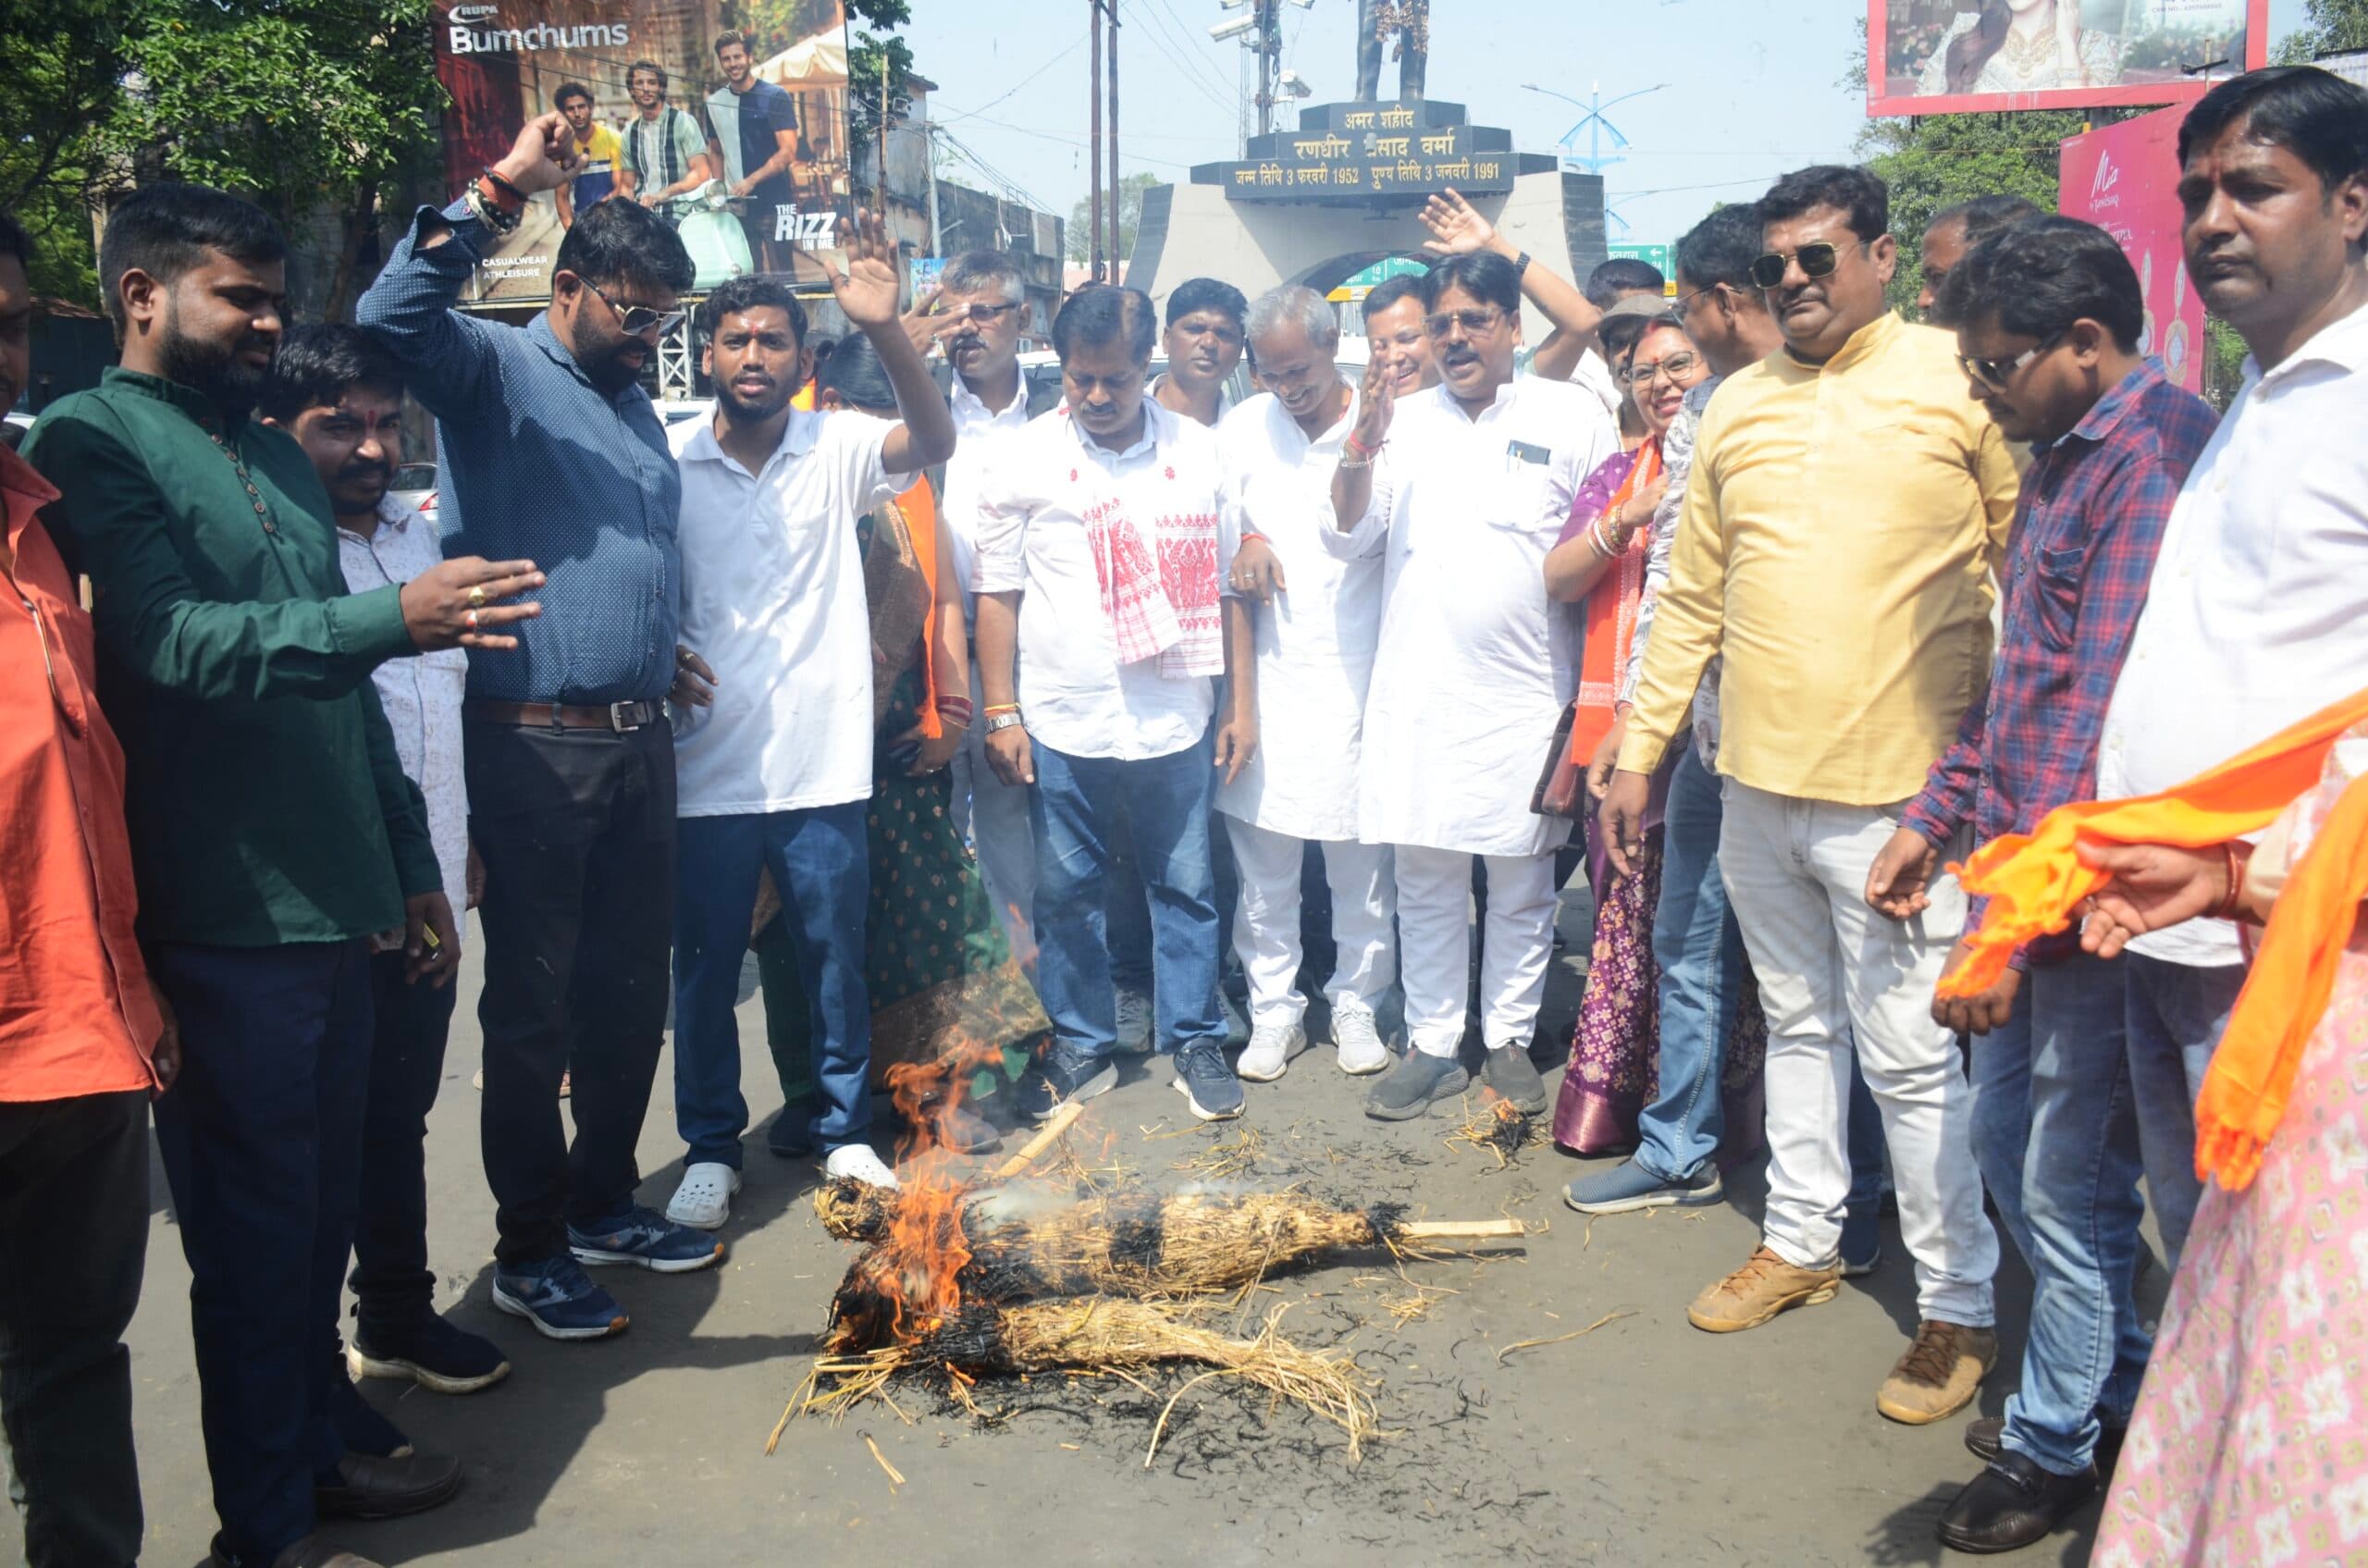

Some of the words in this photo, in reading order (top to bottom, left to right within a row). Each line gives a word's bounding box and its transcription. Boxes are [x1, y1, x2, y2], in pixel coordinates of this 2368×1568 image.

[461, 5, 498, 15] RUPA
[449, 22, 630, 54] Bumchums
[1345, 111, 1375, 130] अमर
[1379, 104, 1414, 129] शहीद
[1294, 133, 1351, 160] रणधीर
[1420, 128, 1455, 155] वर्मा
[1235, 170, 1257, 185] जन्म
[1259, 163, 1284, 186] तिथि
[1287, 169, 1293, 185] 3
[1297, 162, 1328, 185] फरवरी
[1332, 167, 1359, 184] 1952
[1371, 166, 1394, 190] पुण्य
[1397, 160, 1422, 181] तिथि
[1425, 165, 1433, 181] 3
[1436, 156, 1470, 180] जनवरी
[1474, 163, 1499, 179] 1991
[2090, 149, 2119, 198] Mia
[775, 204, 797, 216] THE
[775, 212, 837, 241] RIZZ
[803, 238, 815, 251] IN
[817, 238, 835, 250] ME
[482, 255, 548, 266] CASUALWEAR
[1372, 265, 1382, 275] 10
[484, 268, 540, 279] ATHLEISURE
